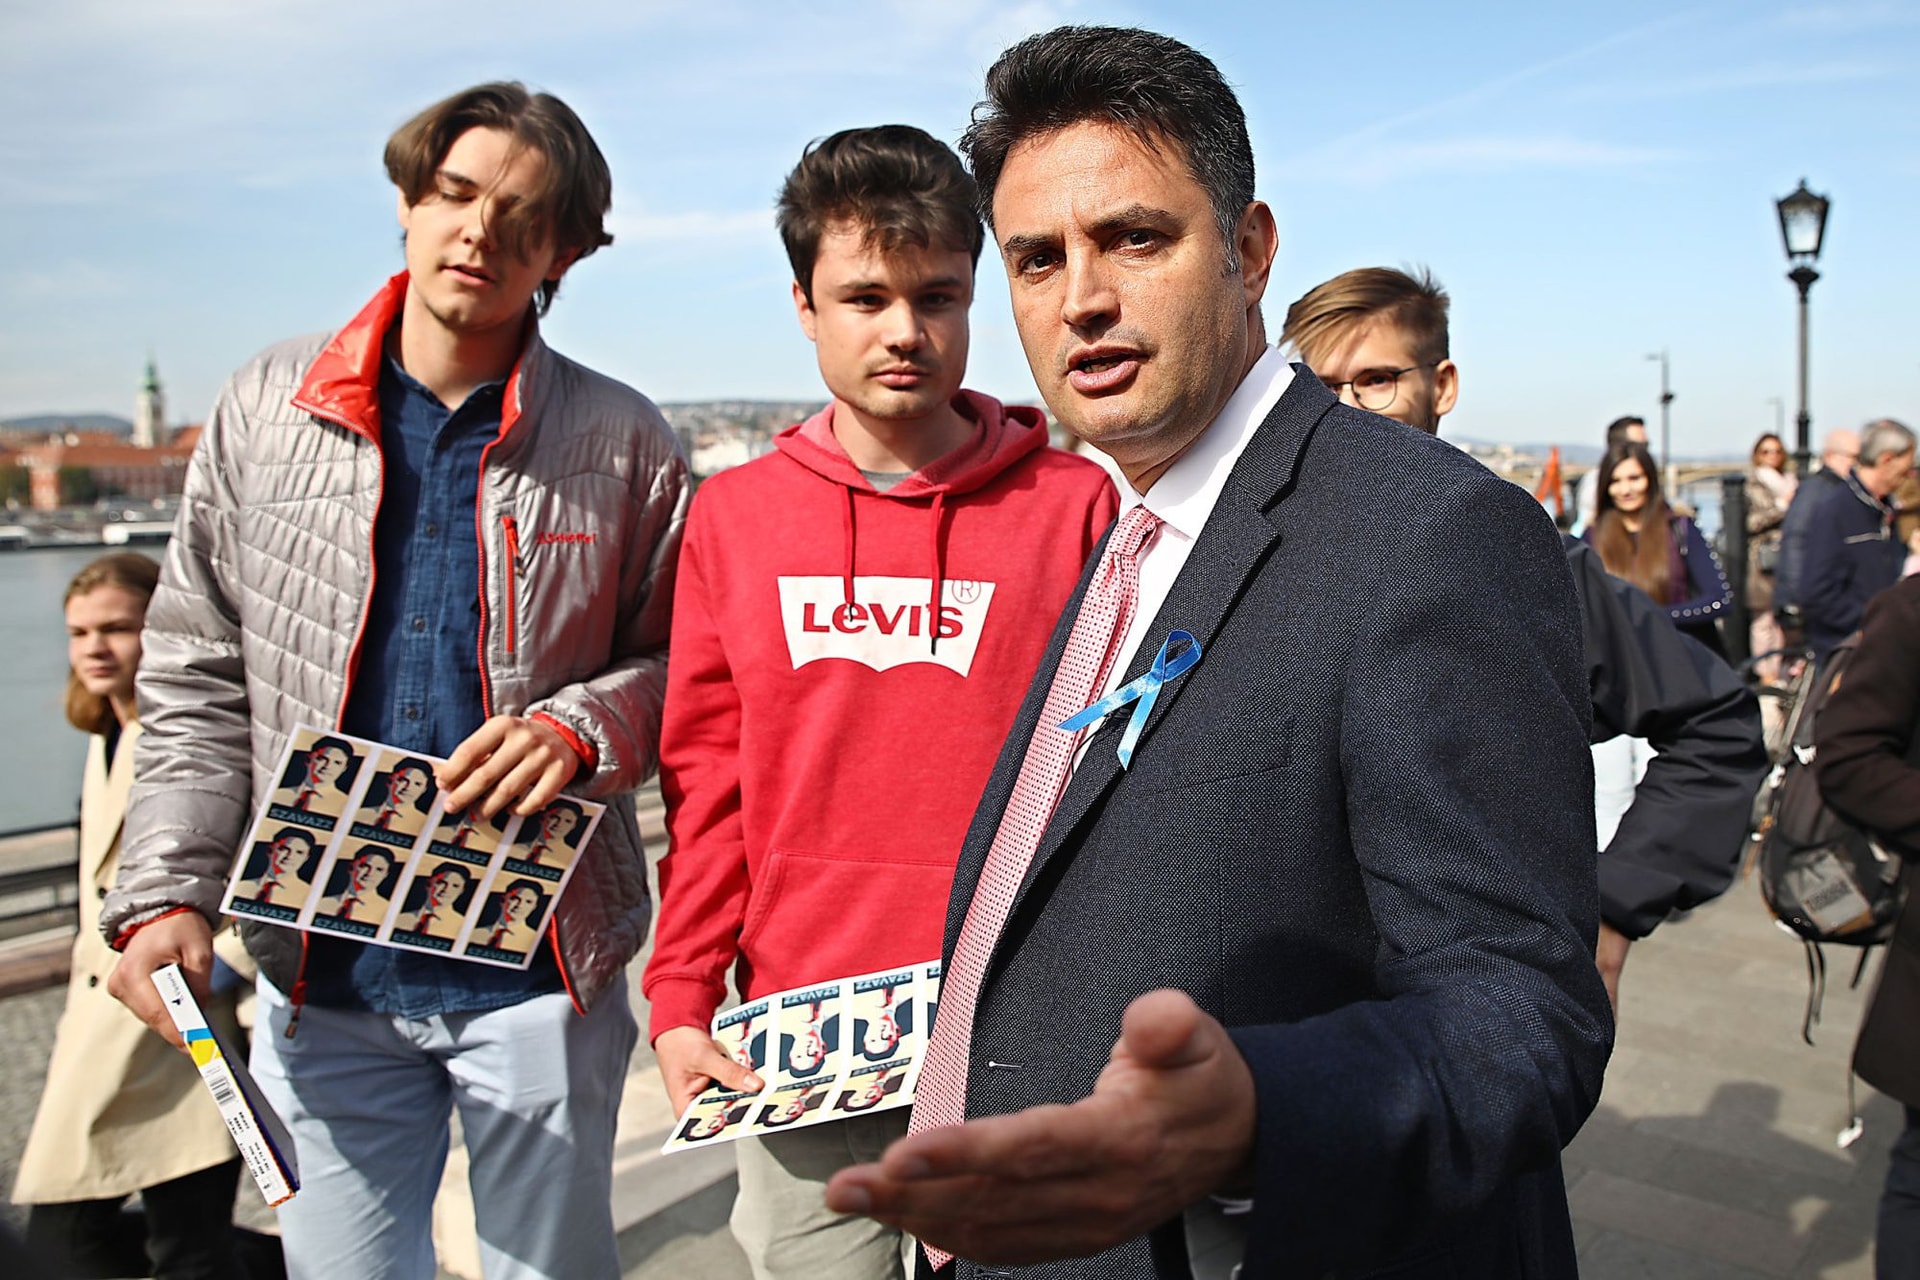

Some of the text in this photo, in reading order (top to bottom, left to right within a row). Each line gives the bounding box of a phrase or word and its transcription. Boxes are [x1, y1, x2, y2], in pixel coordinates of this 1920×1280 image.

[269, 807, 334, 830] SZAVAZZ
[352, 825, 414, 847] SZAVAZZ
[430, 843, 489, 864] SZAVAZZ
[504, 860, 561, 880] SZAVAZZ
[232, 900, 296, 921] SZAVAZZ
[314, 917, 376, 937] SZAVAZZ
[855, 972, 912, 990] SZAVAZZ
[783, 986, 839, 1005] SZAVAZZ
